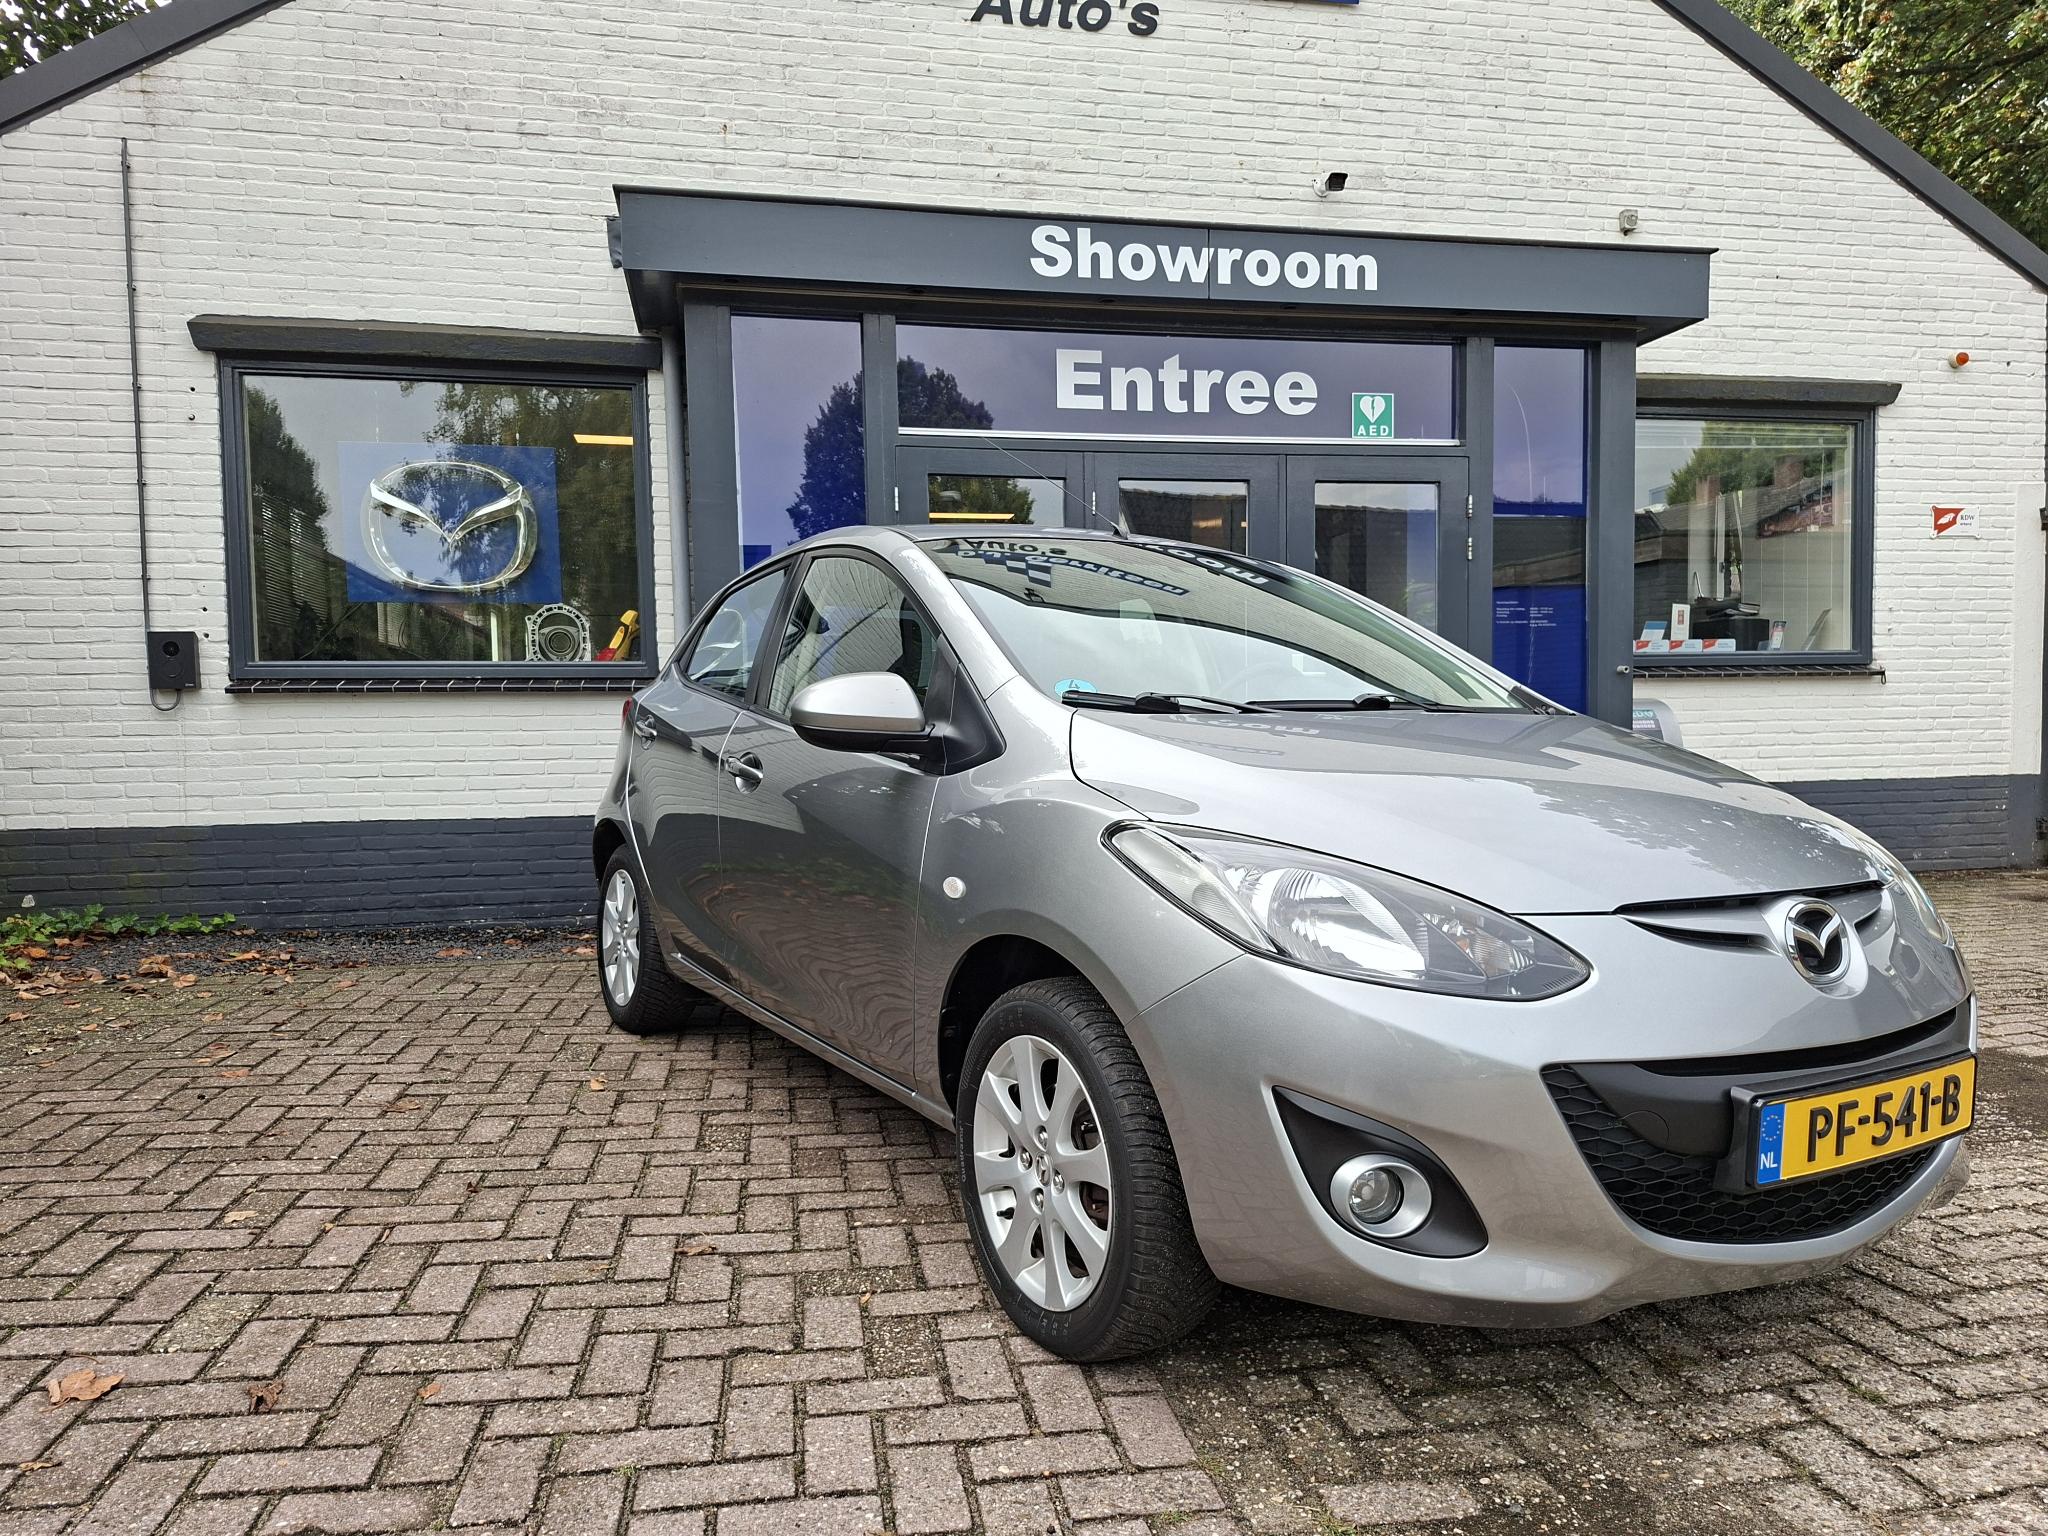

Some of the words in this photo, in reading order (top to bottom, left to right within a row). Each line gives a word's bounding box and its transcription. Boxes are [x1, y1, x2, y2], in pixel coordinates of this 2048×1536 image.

[970, 0, 1160, 36] Auto's
[1030, 225, 1378, 291] Showroom
[1055, 348, 1318, 416] Entree
[1356, 424, 1390, 437] AED
[1807, 1074, 1961, 1162] PF-541-B
[1760, 1151, 1778, 1170] NL
